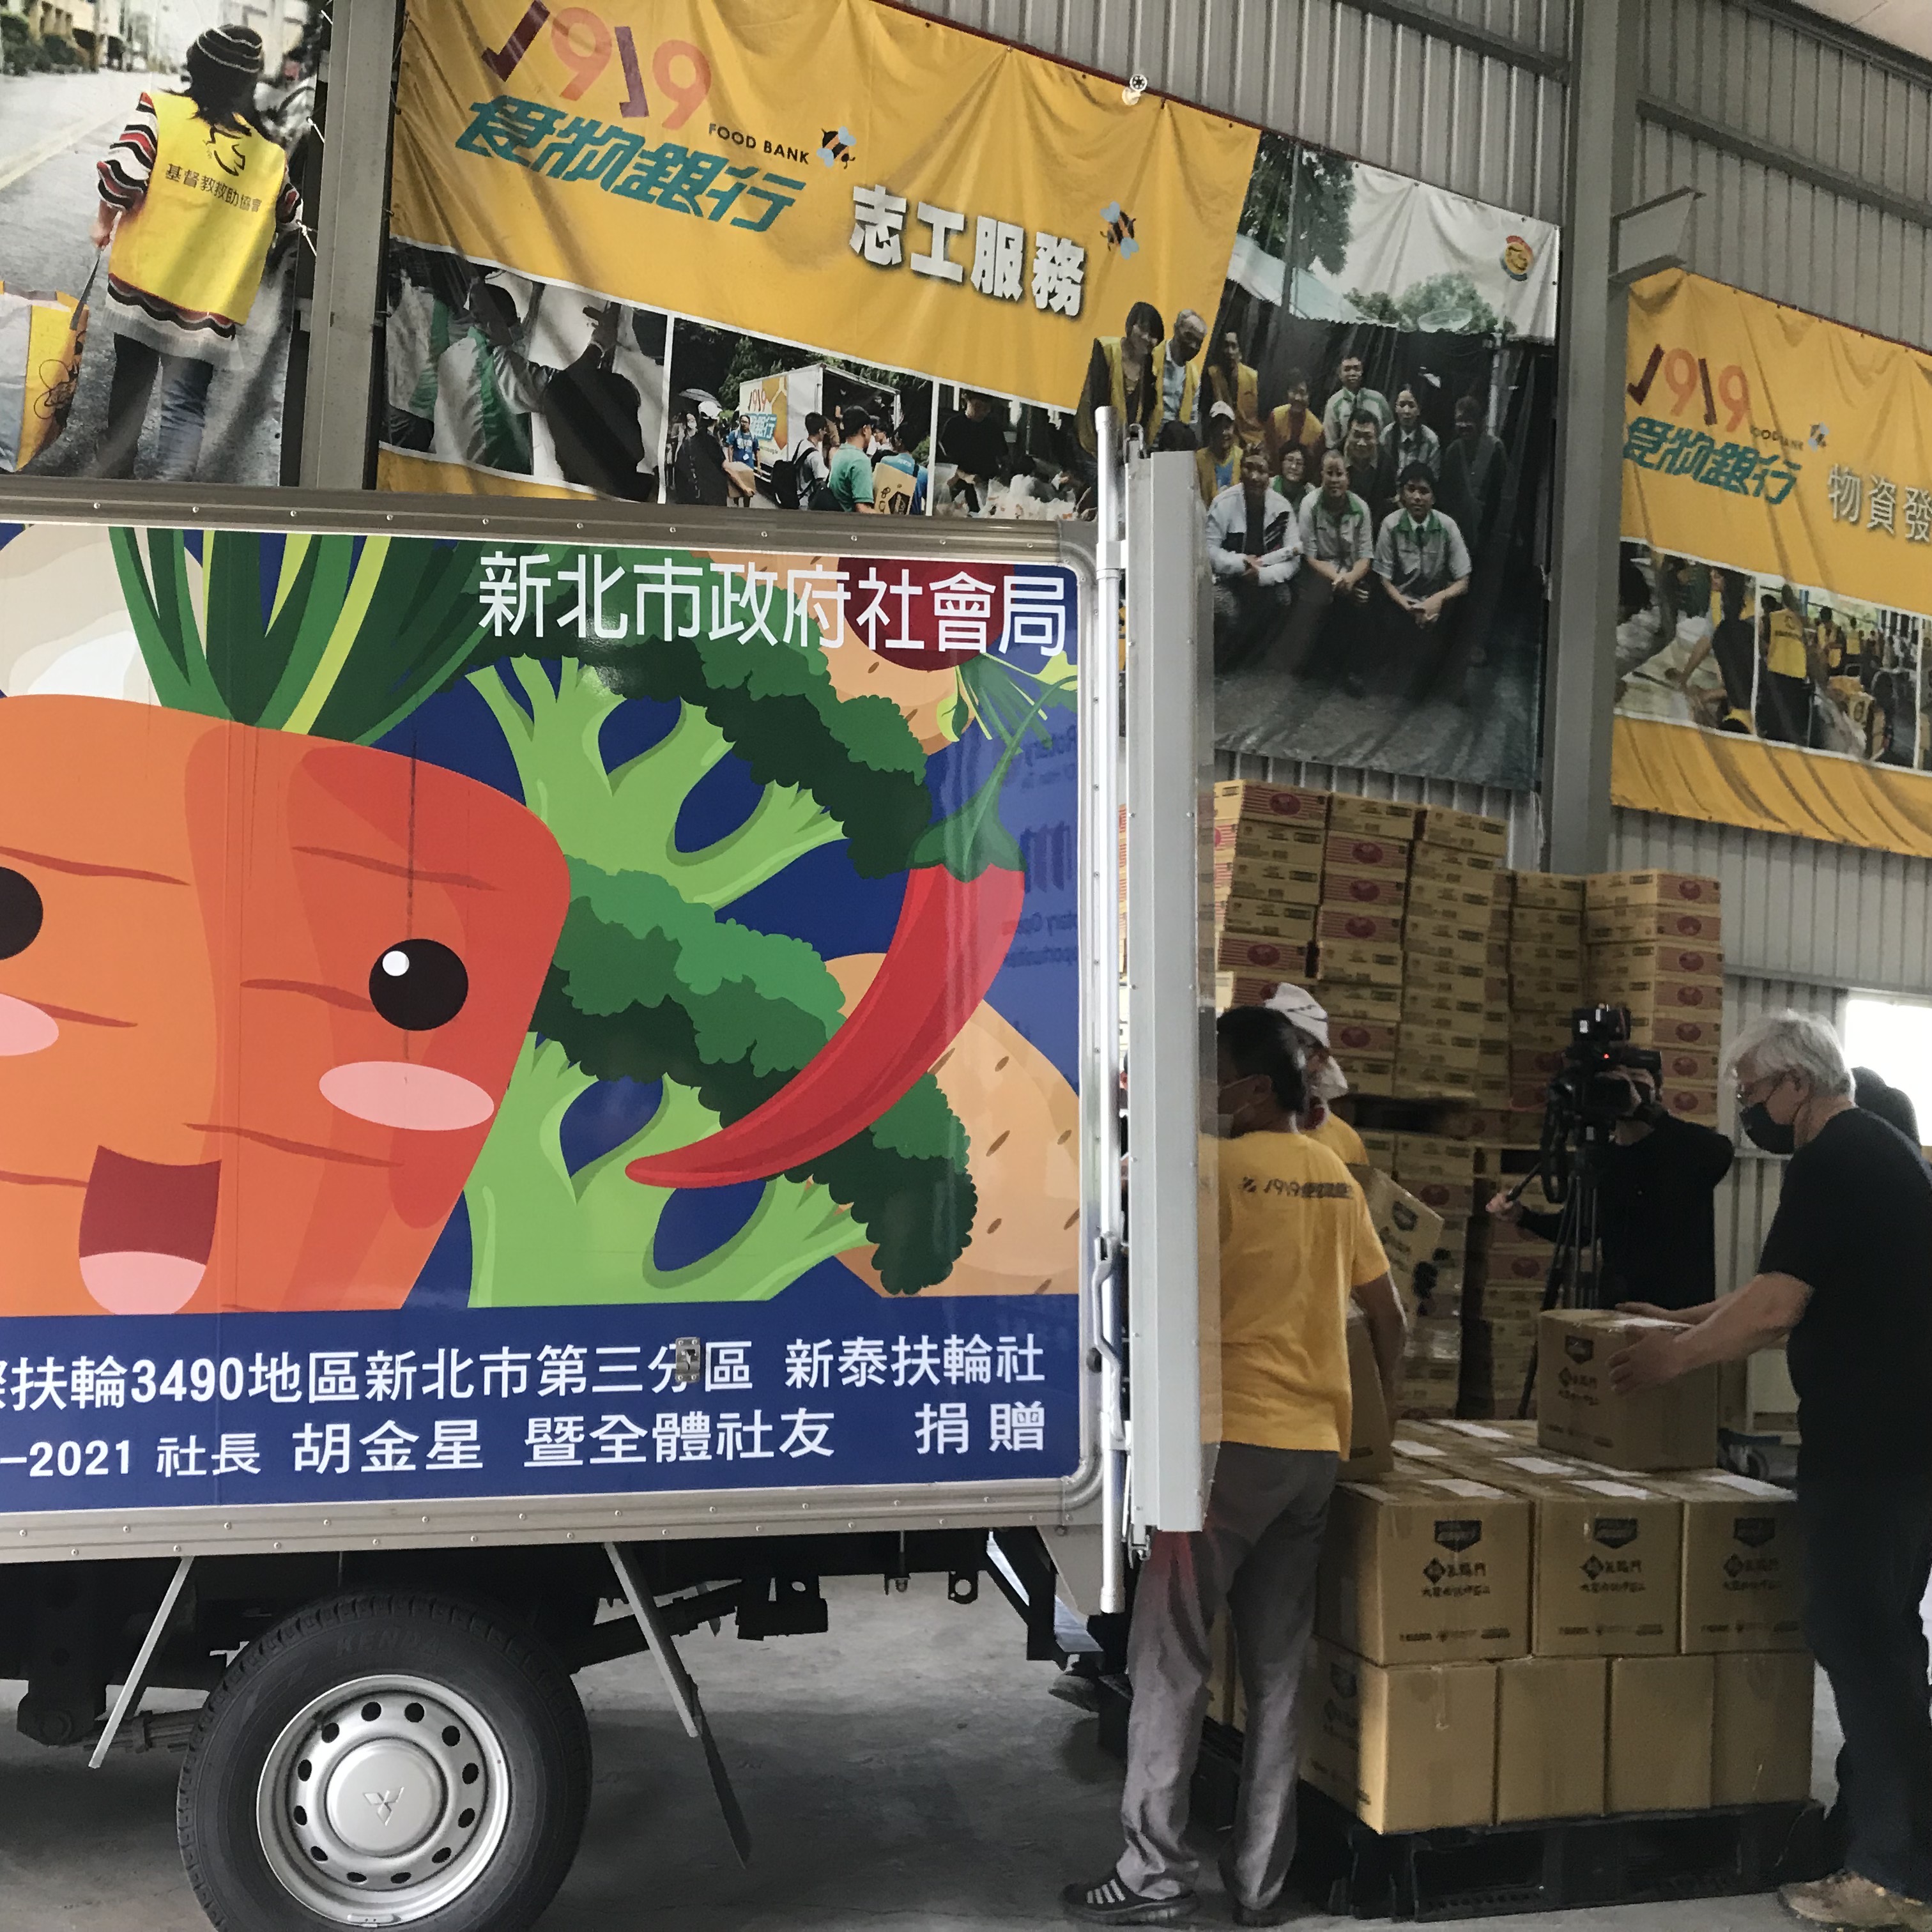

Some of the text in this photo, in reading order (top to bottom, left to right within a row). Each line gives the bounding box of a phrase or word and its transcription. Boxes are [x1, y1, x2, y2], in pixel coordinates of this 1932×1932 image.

[482, 0, 711, 131] 1919
[455, 95, 806, 232] 食物銀行
[709, 122, 809, 165] FOOD BANK
[165, 163, 262, 213] 基督教救助協會
[849, 185, 1085, 316] 志工服務
[1627, 344, 1751, 433] 1919
[1623, 417, 1802, 504] 食物銀行
[1827, 463, 1932, 542] 物資發
[479, 551, 1066, 656] 新北市政府社會局
[0, 1333, 1045, 1411] 扶輪3490地區新北市第三分區 新泰扶輪社
[157, 1434, 261, 1477] 社長
[292, 1419, 483, 1475] 胡金星
[524, 1407, 834, 1467] 暨全體社友
